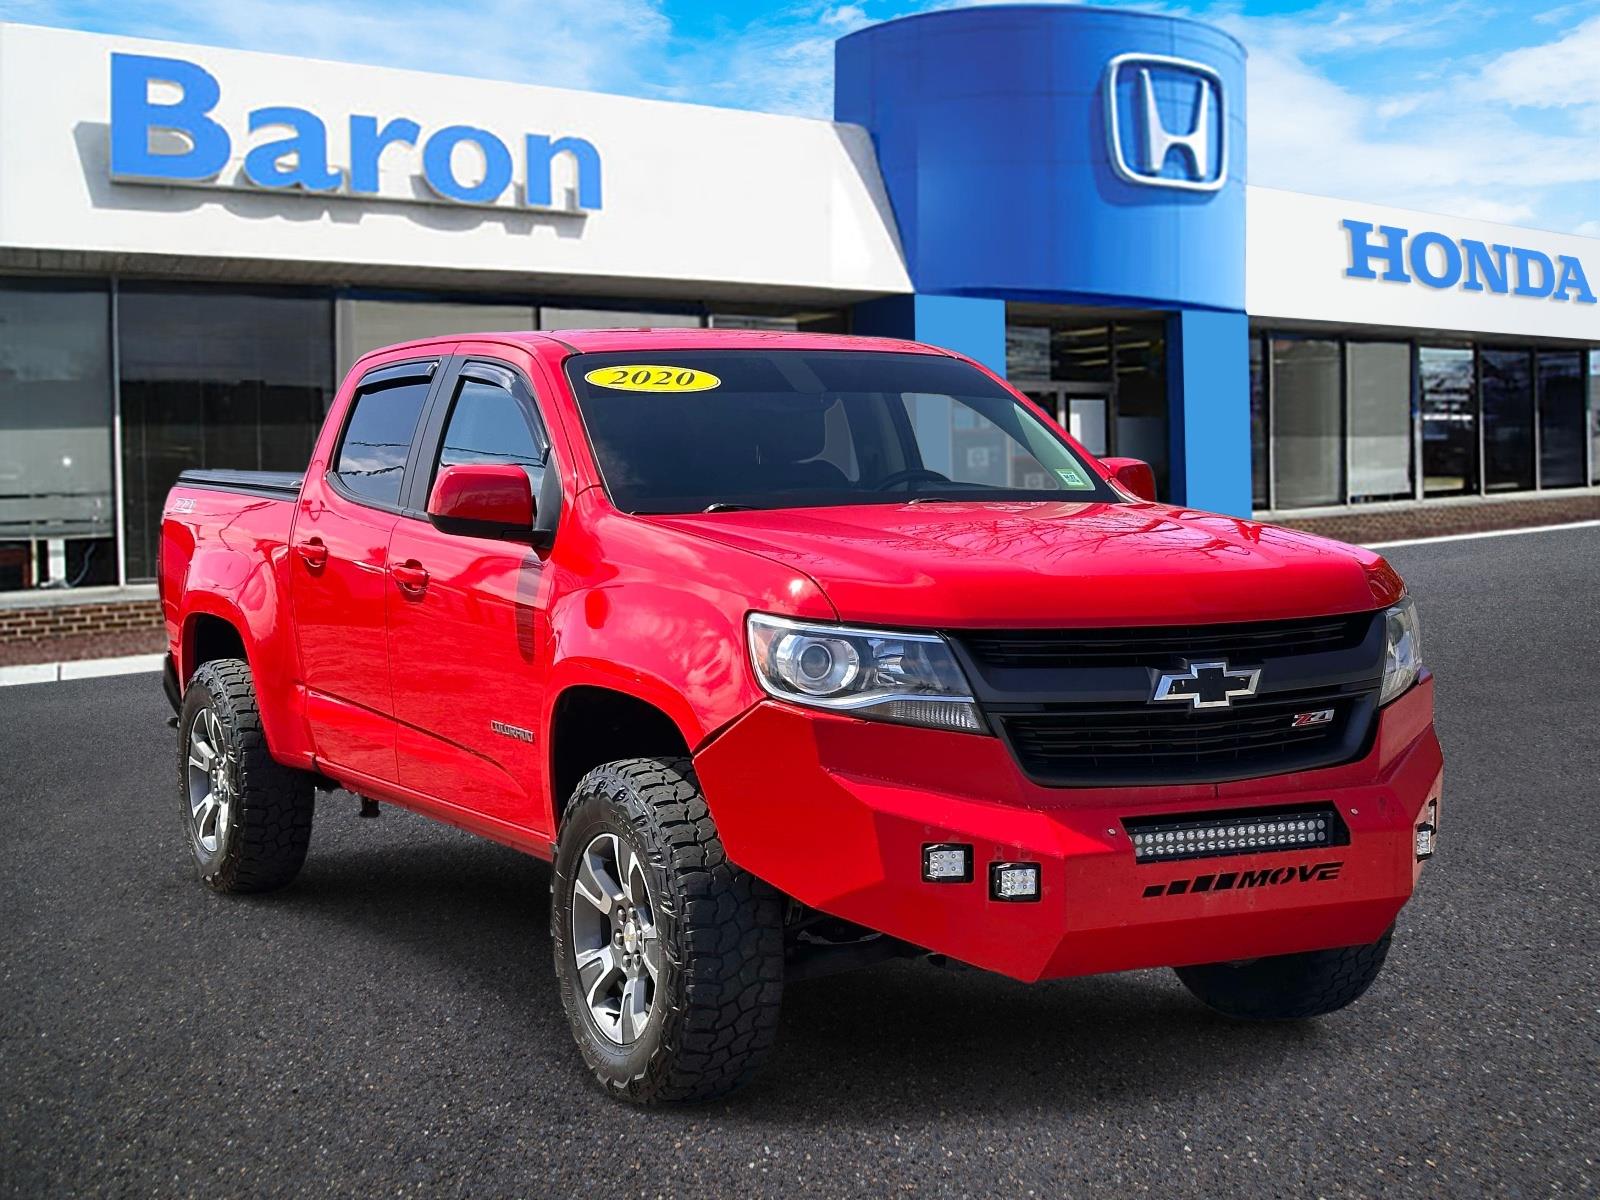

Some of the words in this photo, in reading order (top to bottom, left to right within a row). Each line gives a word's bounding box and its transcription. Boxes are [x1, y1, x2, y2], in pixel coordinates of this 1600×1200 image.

[110, 52, 603, 210] Baron
[1342, 218, 1599, 304] HONDA
[608, 370, 695, 386] 2020
[1291, 708, 1335, 728] Z71
[1236, 861, 1345, 889] MOVE
